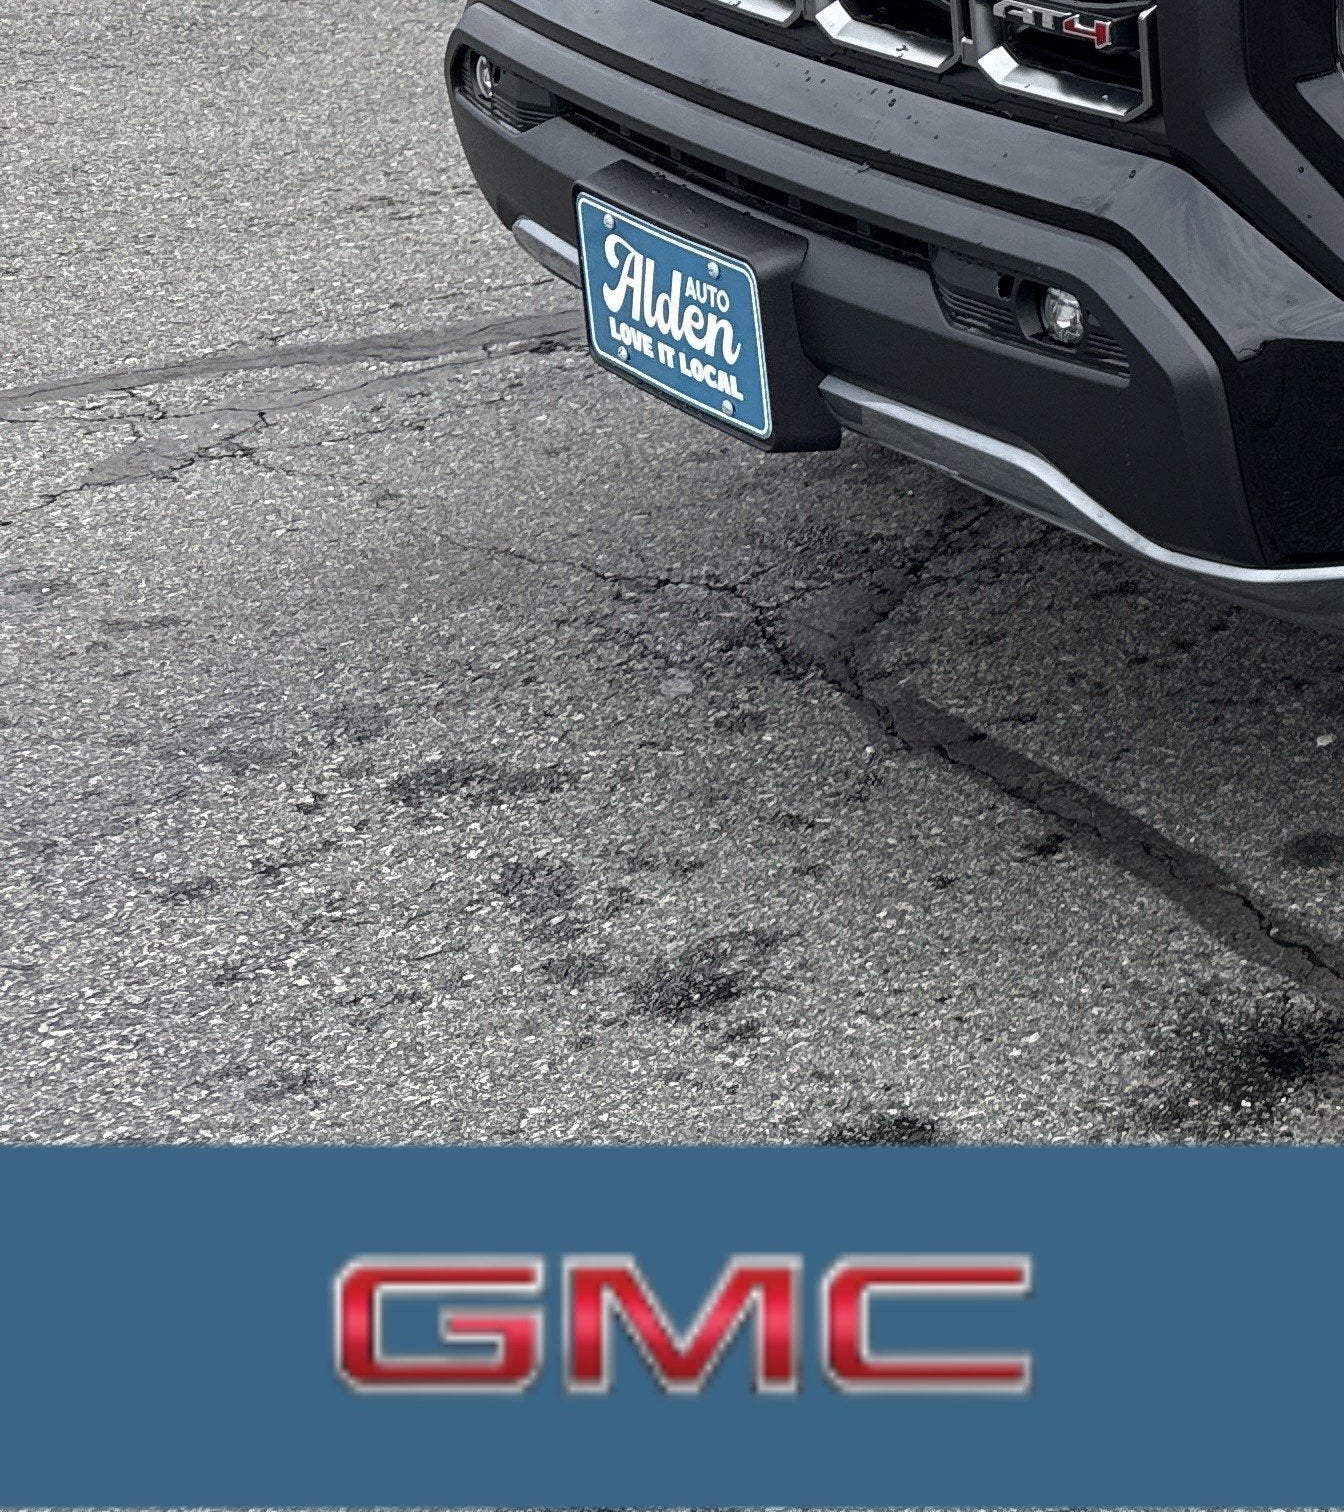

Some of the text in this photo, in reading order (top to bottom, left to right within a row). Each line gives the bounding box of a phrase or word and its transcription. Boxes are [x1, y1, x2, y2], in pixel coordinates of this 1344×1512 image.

[603, 233, 742, 366] Alden
[685, 276, 730, 313] AUTO
[608, 316, 745, 402] LOVE IT LOCAL
